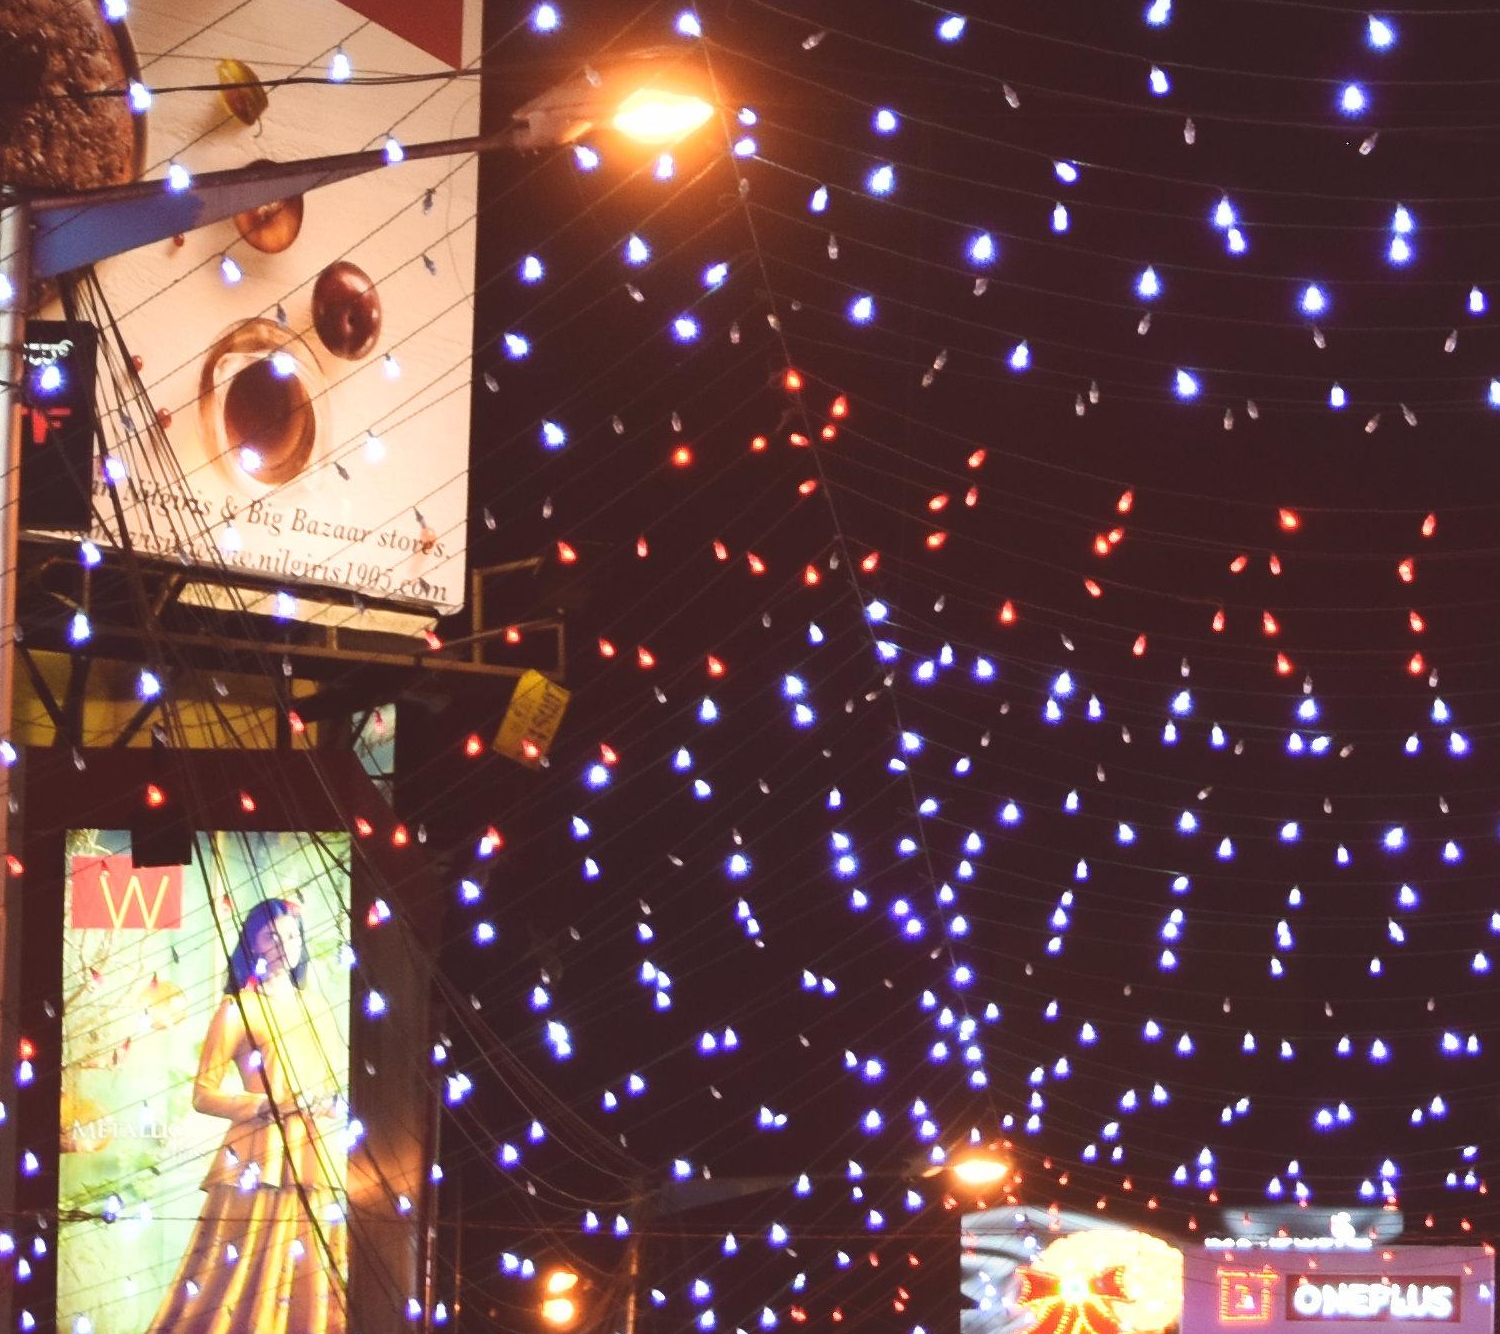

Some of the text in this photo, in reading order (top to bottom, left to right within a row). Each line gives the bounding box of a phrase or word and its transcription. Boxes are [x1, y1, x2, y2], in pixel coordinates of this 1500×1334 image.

[247, 499, 283, 536] Big
[290, 507, 371, 543] Bazaar
[100, 874, 169, 930] W
[1293, 1282, 1454, 1318] ONEPLUS
